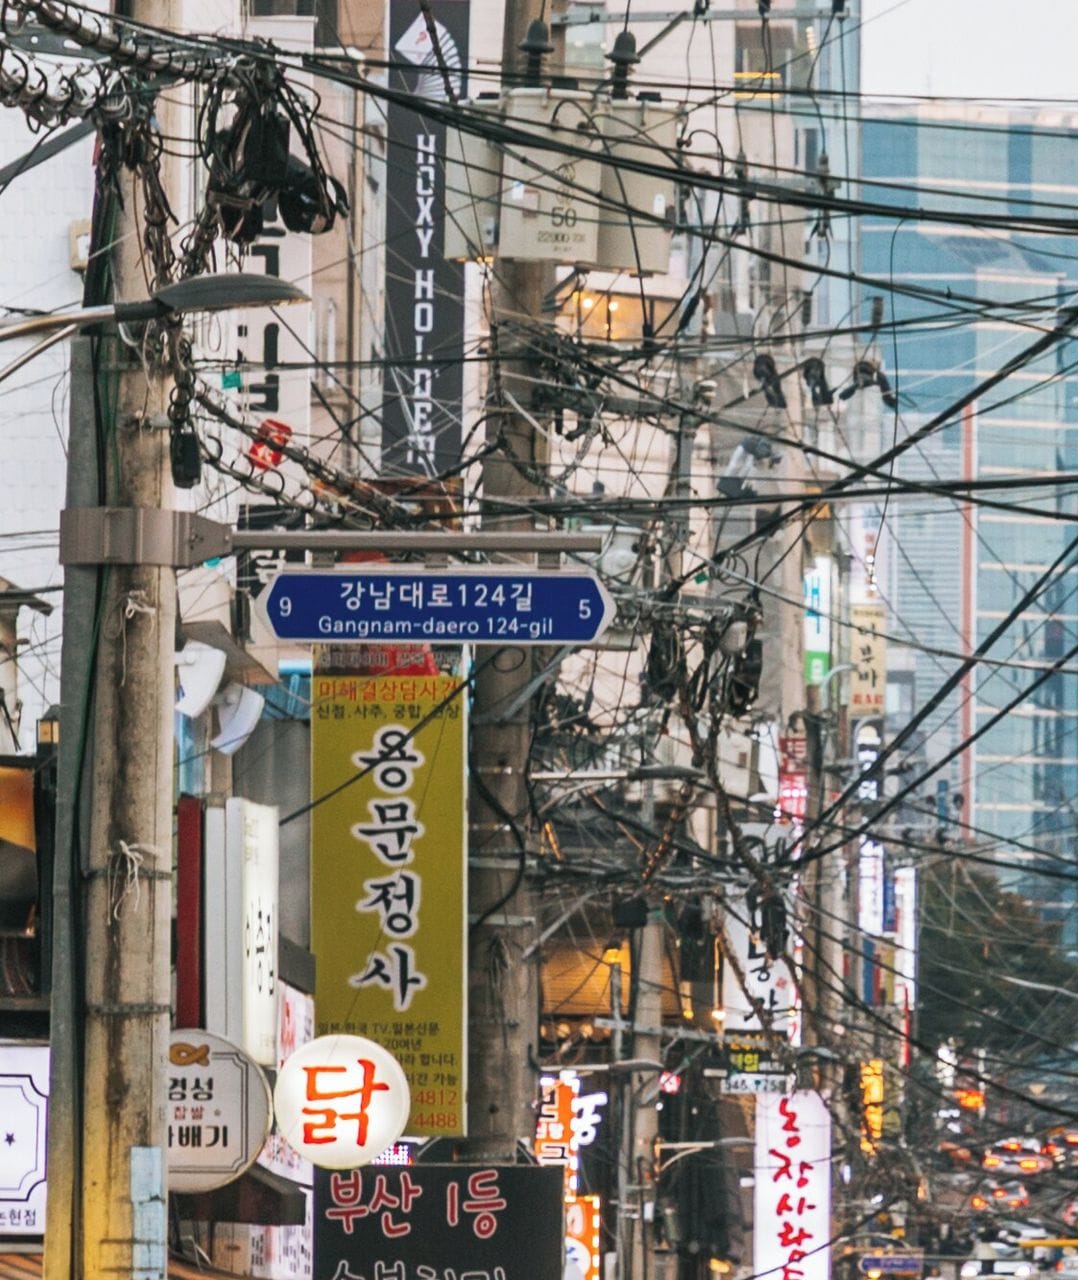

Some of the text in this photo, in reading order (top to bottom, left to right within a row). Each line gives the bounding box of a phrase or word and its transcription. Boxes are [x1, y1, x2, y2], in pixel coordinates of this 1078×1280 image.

[279, 597, 292, 617] 9
[340, 581, 533, 612] 강남대로124길
[578, 598, 592, 619] 5
[318, 616, 554, 639] Gangnam-daero 124-gil
[352, 725, 426, 1011] 용문정사
[302, 1058, 390, 1147] 닭
[415, 1090, 458, 1107] 4812
[326, 1170, 422, 1238] 부산
